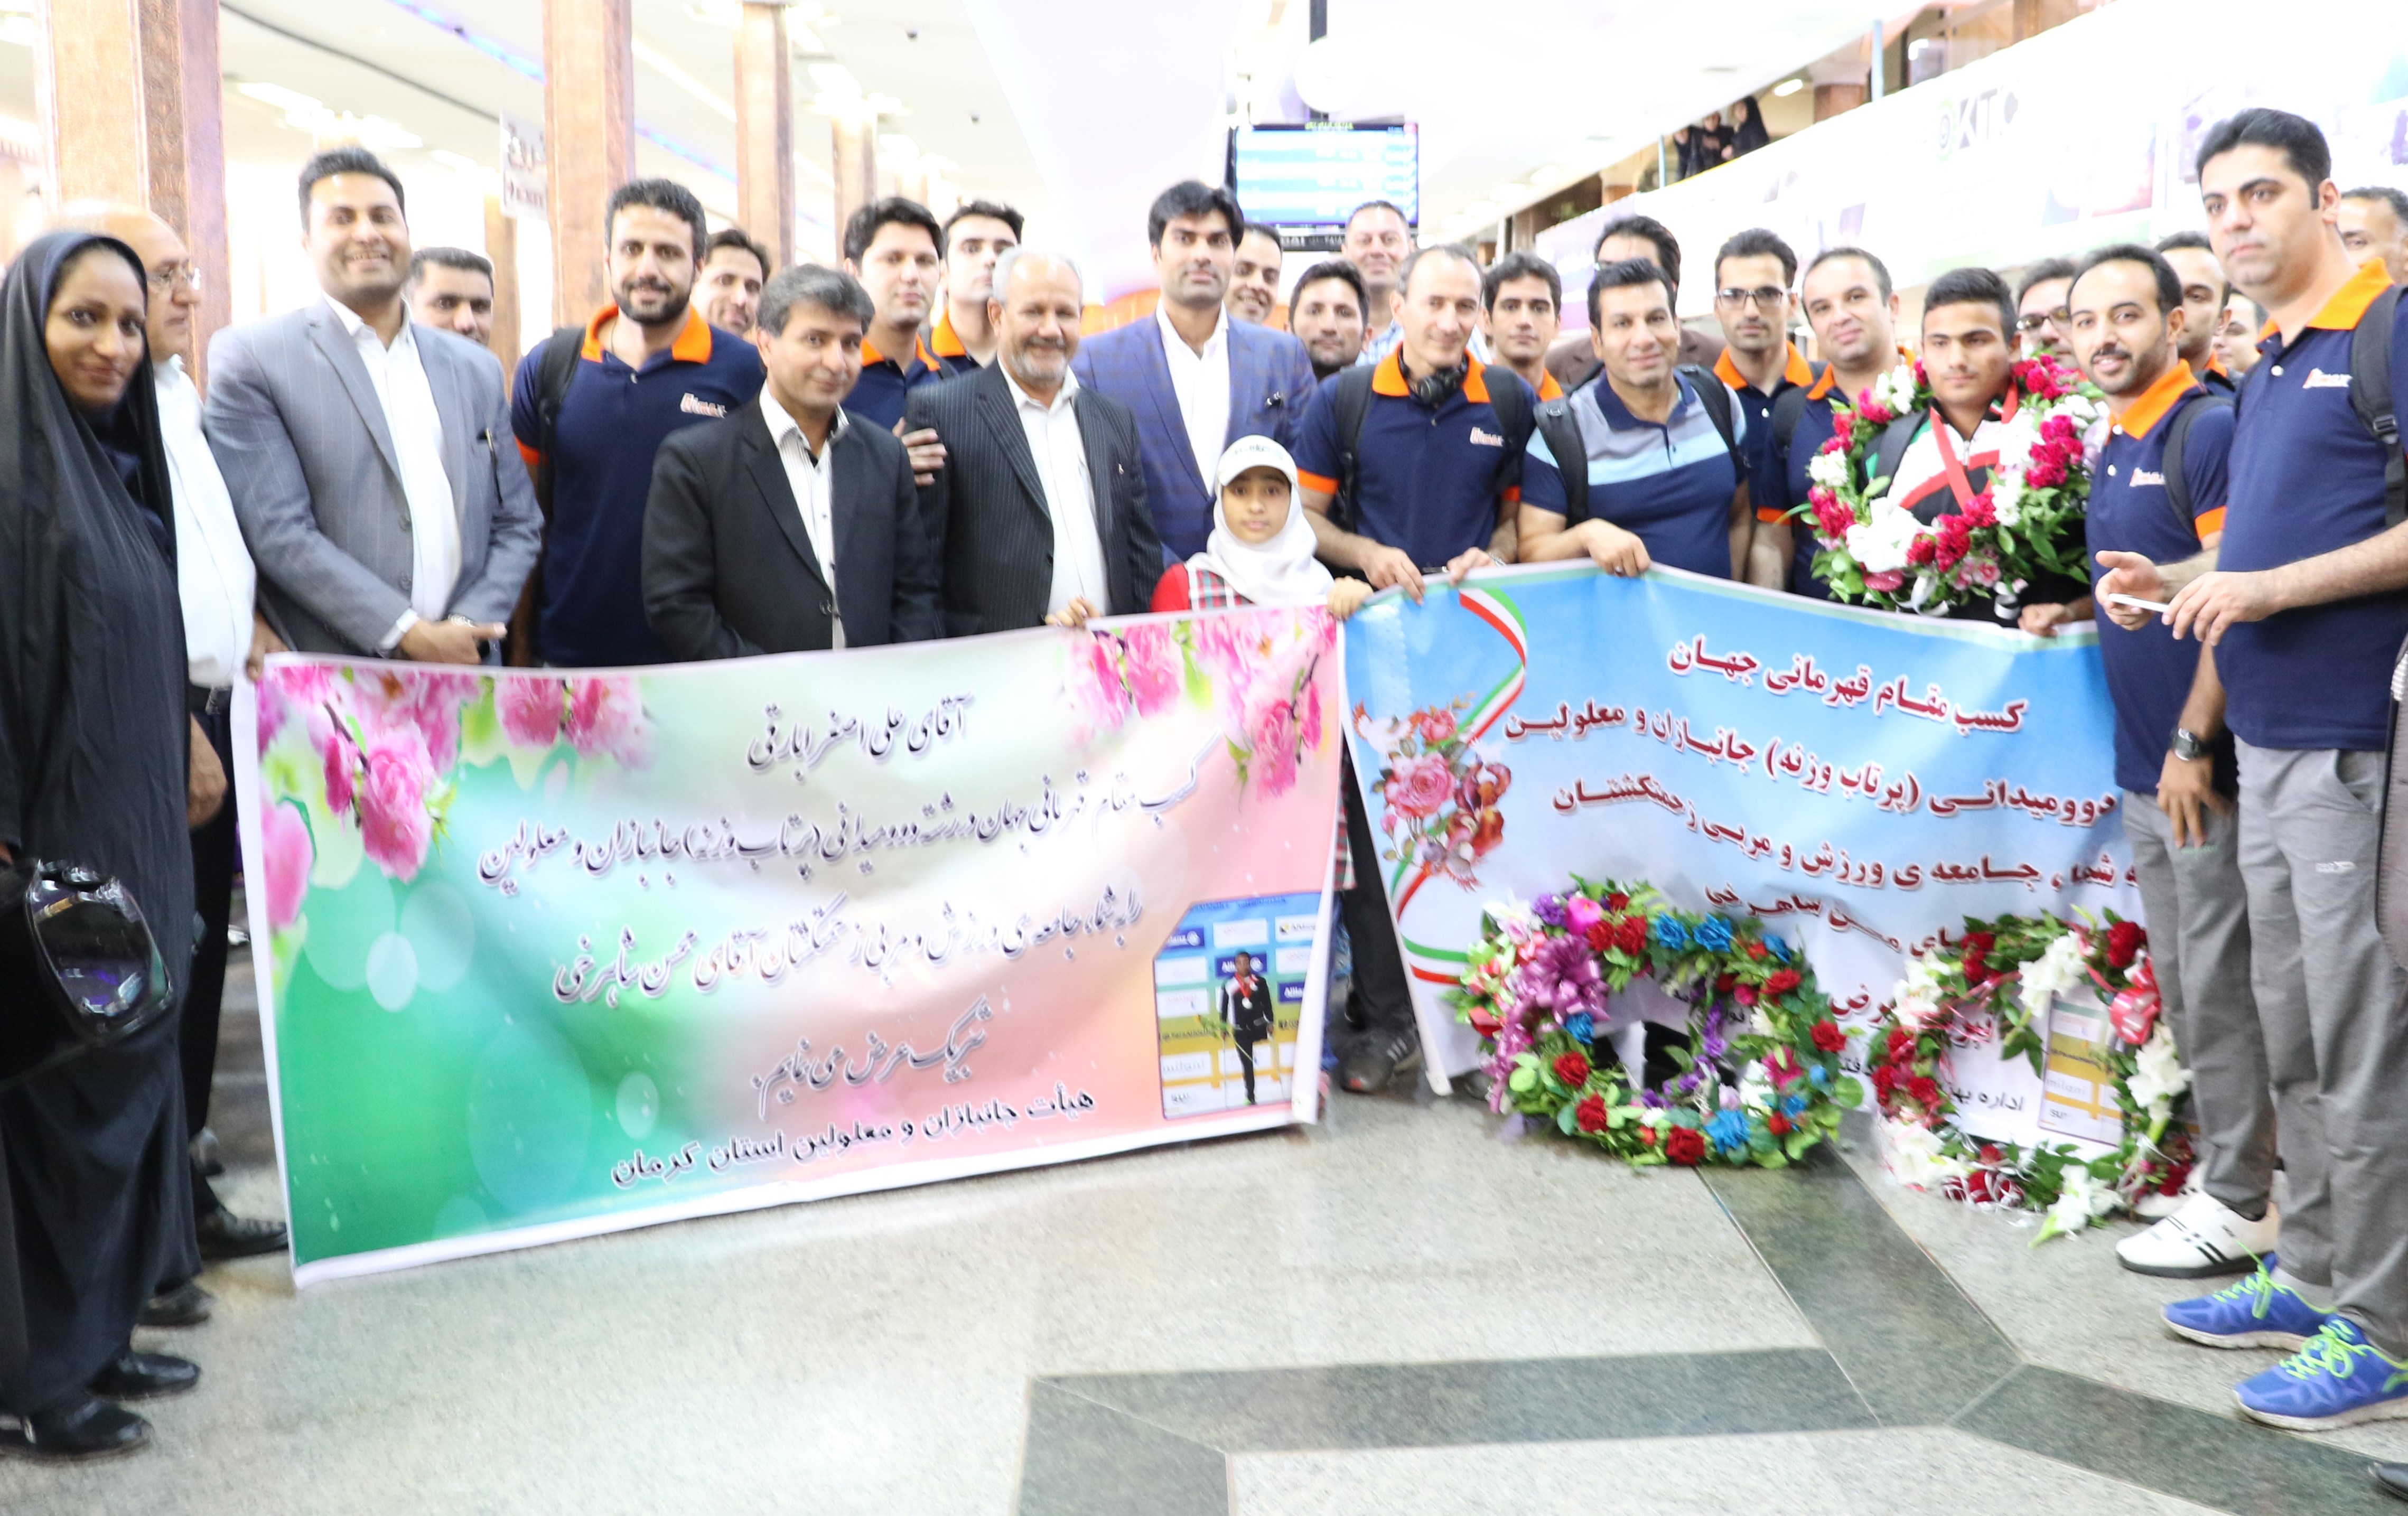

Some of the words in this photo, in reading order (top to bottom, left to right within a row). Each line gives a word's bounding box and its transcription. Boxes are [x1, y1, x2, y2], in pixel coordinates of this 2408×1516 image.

[1669, 637, 1759, 687] جهان
[1766, 655, 1870, 707] قهرمانی
[1506, 700, 1626, 740] معلولین
[1635, 707, 1647, 732] و
[1874, 676, 1949, 719] مقام
[1954, 700, 2028, 737] کسب
[869, 705, 904, 757] علی
[907, 691, 972, 753] آقای
[1651, 710, 1755, 771] جانبازان
[1139, 727, 1221, 827] کسب
[1028, 769, 1089, 834] قهرمانی
[977, 798, 1027, 853] جهان
[1701, 817, 1771, 857] مربی
[479, 818, 567, 894] معلولین
[568, 839, 584, 865] و
[584, 818, 680, 886] جانبازان
[1779, 844, 1793, 867] و
[1800, 841, 1884, 886] ورزش
[1930, 855, 2040, 892] جامعه
[693, 925, 768, 993] آقای
[808, 1045, 844, 1089] می
[844, 1031, 911, 1085] عرض
[791, 1119, 894, 1161] معلولین
[901, 1118, 913, 1144] و
[922, 1099, 1019, 1137] جانبازان
[611, 1141, 701, 1188] کرمان
[706, 1130, 784, 1170] استان
